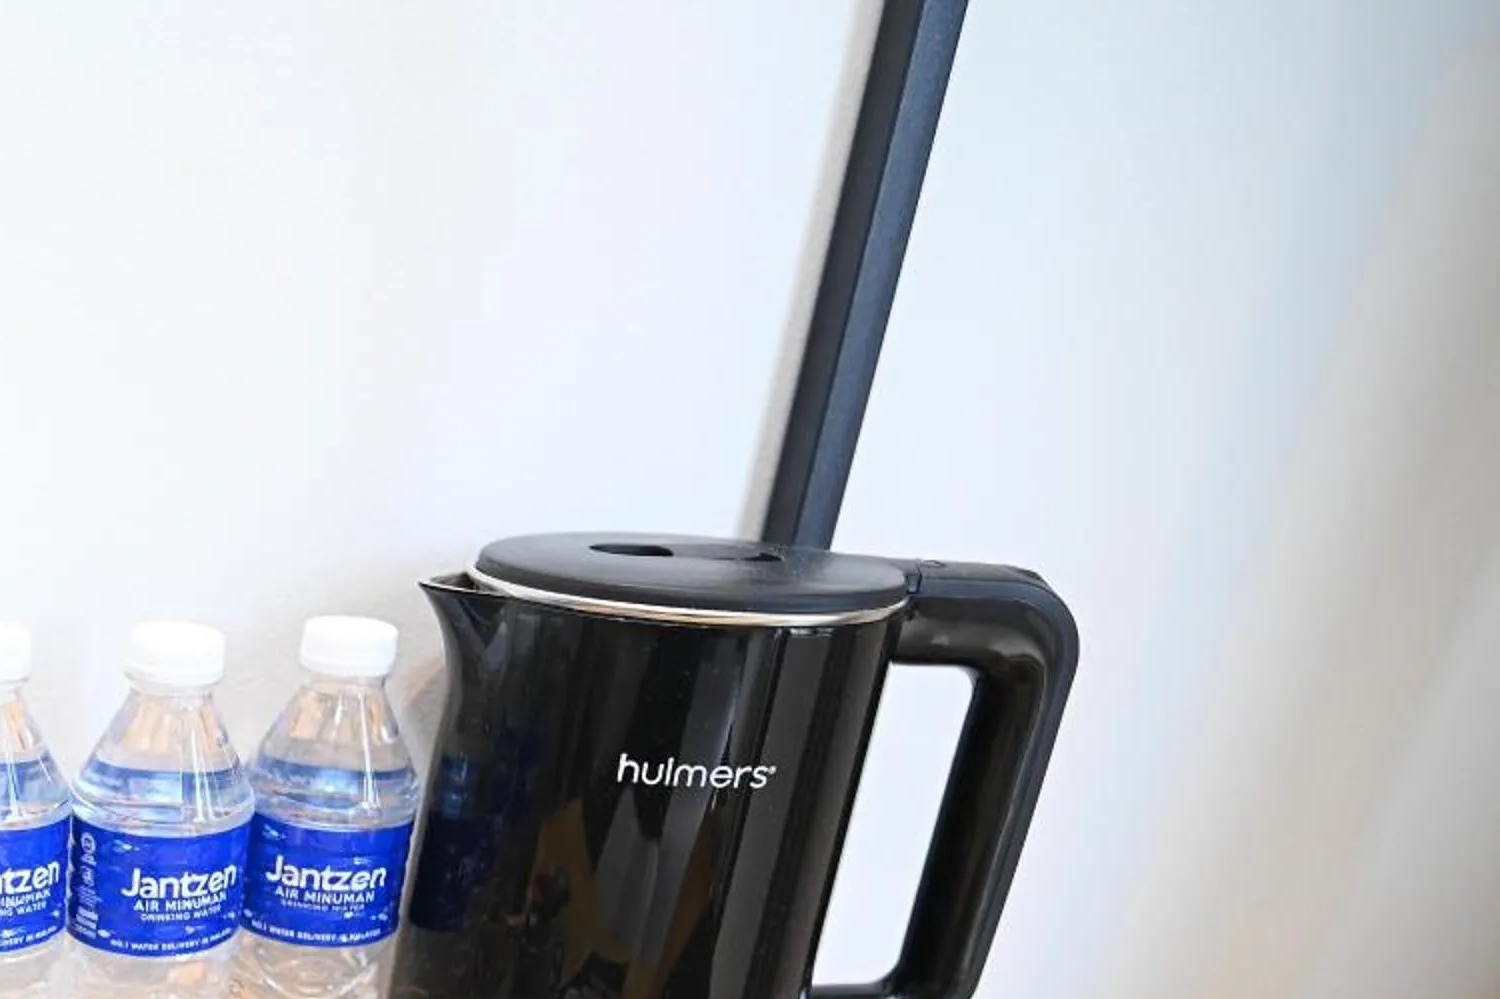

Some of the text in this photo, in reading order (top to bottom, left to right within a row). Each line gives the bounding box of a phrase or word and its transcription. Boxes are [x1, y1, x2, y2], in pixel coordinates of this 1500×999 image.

[616, 753, 773, 789] hulmers
[121, 864, 238, 899] Jantzen
[265, 854, 387, 892] Jantzen
[133, 892, 228, 912] AIR MINUMAN
[275, 885, 375, 905] AIR MINUMAN
